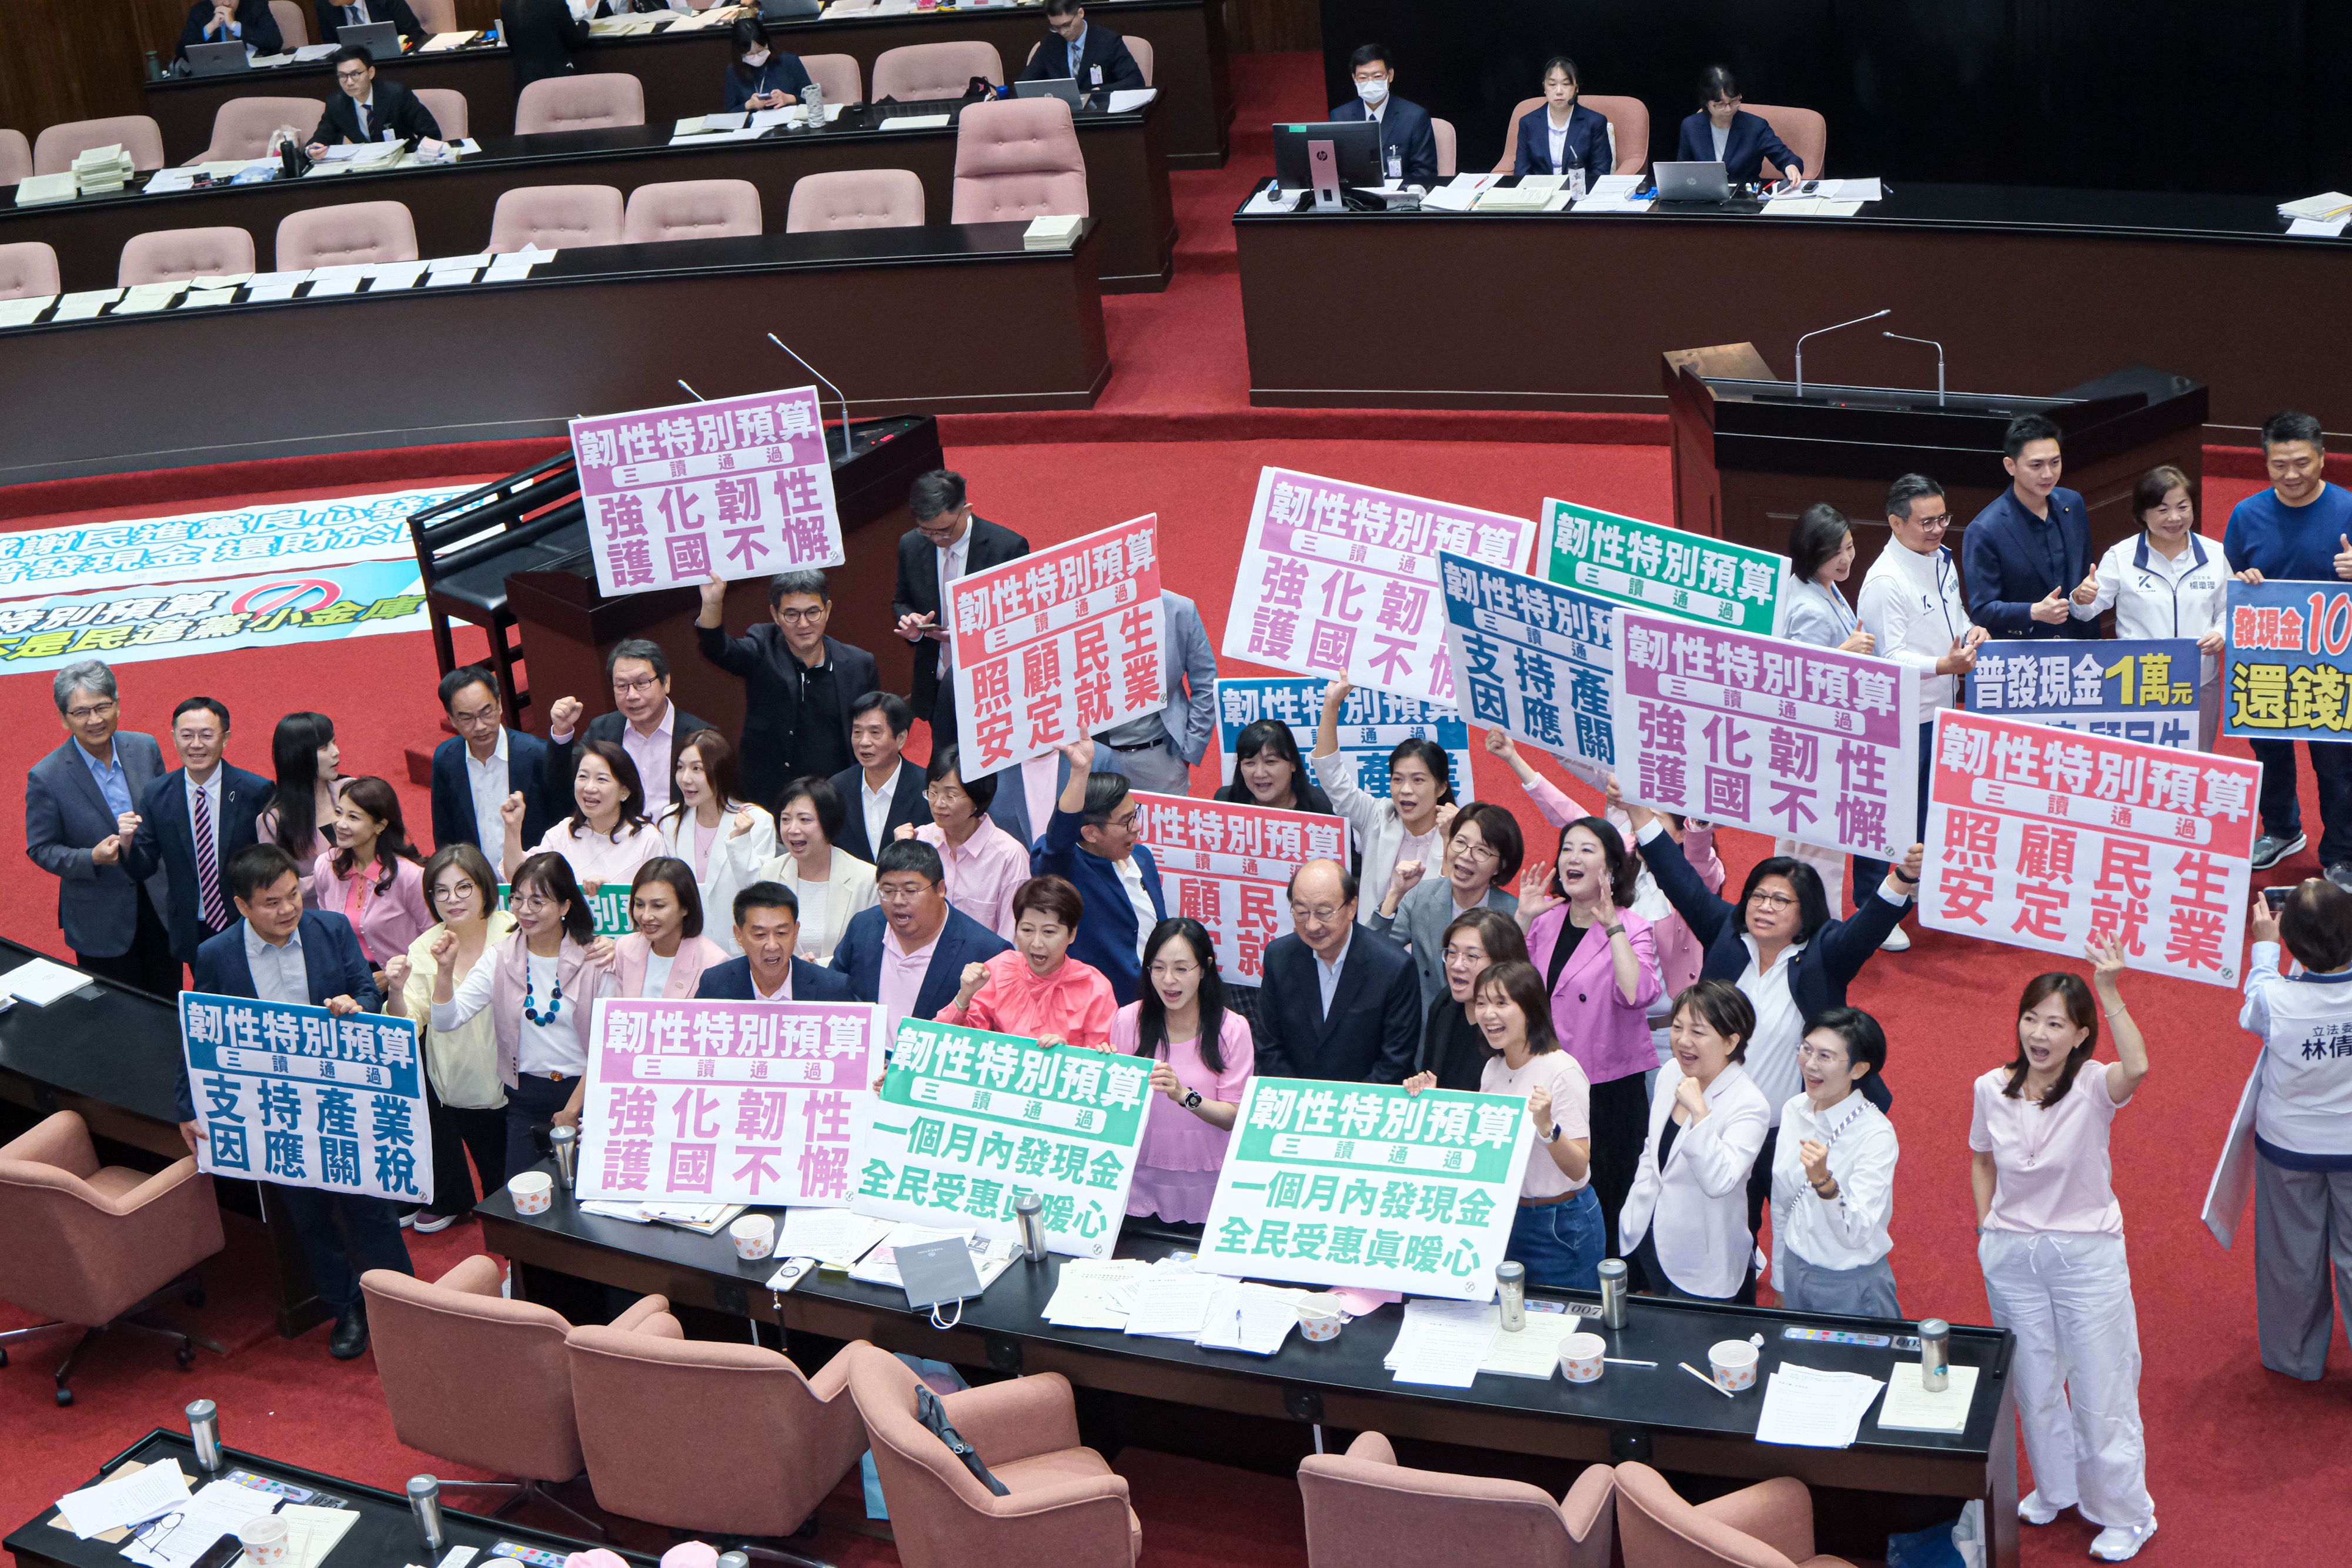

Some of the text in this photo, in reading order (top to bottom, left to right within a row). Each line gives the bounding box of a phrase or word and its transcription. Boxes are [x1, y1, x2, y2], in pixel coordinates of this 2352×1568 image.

[579, 400, 816, 469] 韌性特別預算
[623, 447, 784, 484] 三讀通過
[598, 467, 823, 541] 強化韌性
[1269, 480, 1516, 569] 韌性特別預算
[606, 515, 830, 588] 護國不懈
[957, 529, 1156, 636] 韌性特別預算
[1300, 534, 1416, 574] 三讀通
[1554, 512, 1776, 606] 韌性特別預算
[0, 590, 230, 634] 特別預算
[995, 586, 1128, 648] 三讀通過
[1261, 556, 1445, 646] 強化韌
[1585, 567, 1734, 622] 三讀通過
[971, 606, 1158, 718] 照顧民生
[1485, 613, 1588, 660] 三讀通
[1628, 625, 1897, 717] 韌性特別預算
[976, 654, 1160, 768] 安定就業
[1462, 633, 1613, 720] 支持產
[1671, 679, 1853, 731] 三讀通過
[1973, 653, 2193, 710] 普發現金1萬元
[2230, 661, 2352, 733] 還錢
[1468, 675, 1615, 765] 因應關
[1638, 700, 1887, 798] 強化韌性
[1638, 753, 1887, 852] 護國不懈
[1940, 723, 2253, 823] 韌性特別預算
[1986, 785, 2196, 839] 三讀通過
[1942, 807, 2230, 915] 照顧民生
[1158, 874, 1278, 934] 顧民
[1940, 866, 2227, 971] 安定就業
[188, 1002, 414, 1069] 韌性特別預算
[226, 1051, 382, 1085] 三讀通過
[606, 1009, 867, 1060] 韌性特別預算
[890, 1026, 1147, 1112] 韌性特別預算
[644, 1059, 822, 1081] 三讀通過
[202, 1074, 415, 1146] 支持產業
[607, 1085, 851, 1142] 強化韌性
[921, 1082, 1094, 1131] 三讀通過
[1249, 1086, 1520, 1149] 韌性特別預算
[208, 1121, 419, 1196] 因應關稅
[601, 1139, 849, 1199] 護國不懈
[872, 1115, 1124, 1191] 一個月內發現金
[1281, 1138, 1462, 1170] 三讀通過
[1231, 1170, 1496, 1228] 一個月內發現金
[1571, 1305, 1602, 1316] 007
